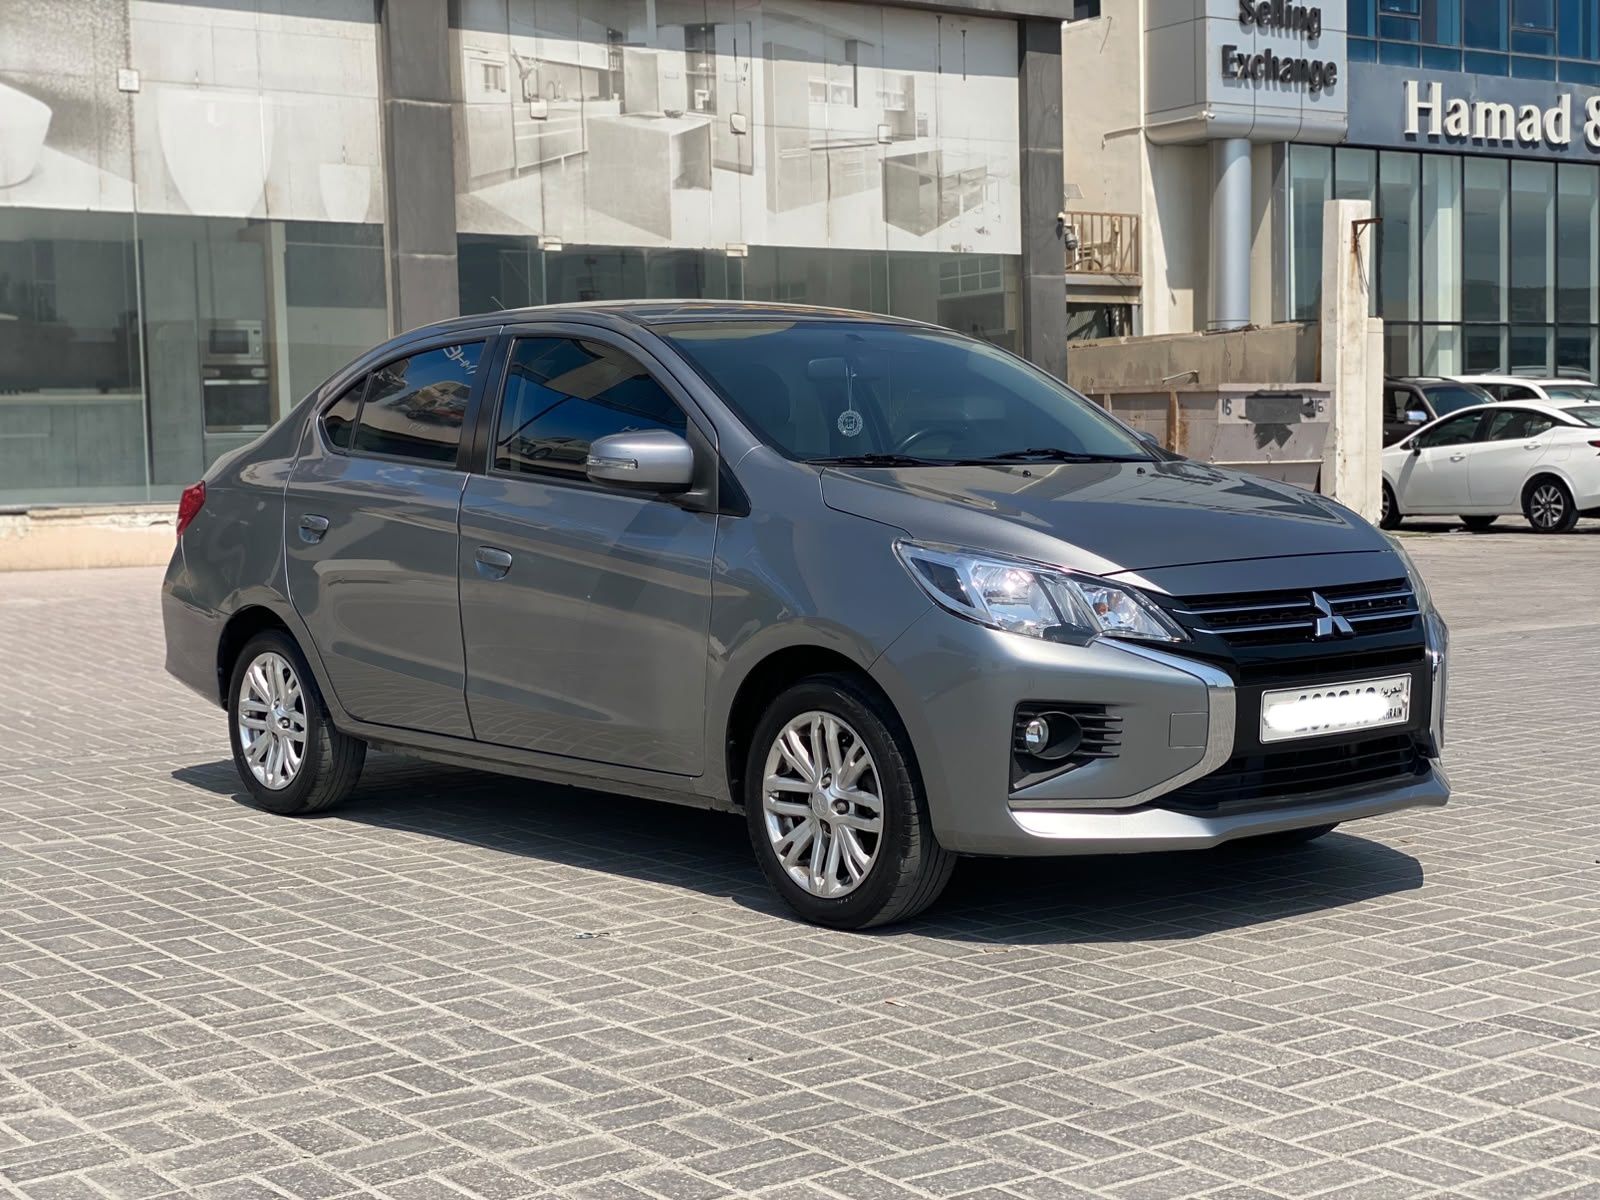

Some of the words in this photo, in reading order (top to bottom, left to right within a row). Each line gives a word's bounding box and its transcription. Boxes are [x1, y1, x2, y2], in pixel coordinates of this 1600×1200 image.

[1239, 0, 1321, 39] Selling
[1221, 44, 1337, 93] Exchange
[1403, 80, 1571, 145] Hamad
[1221, 398, 1232, 416] 16
